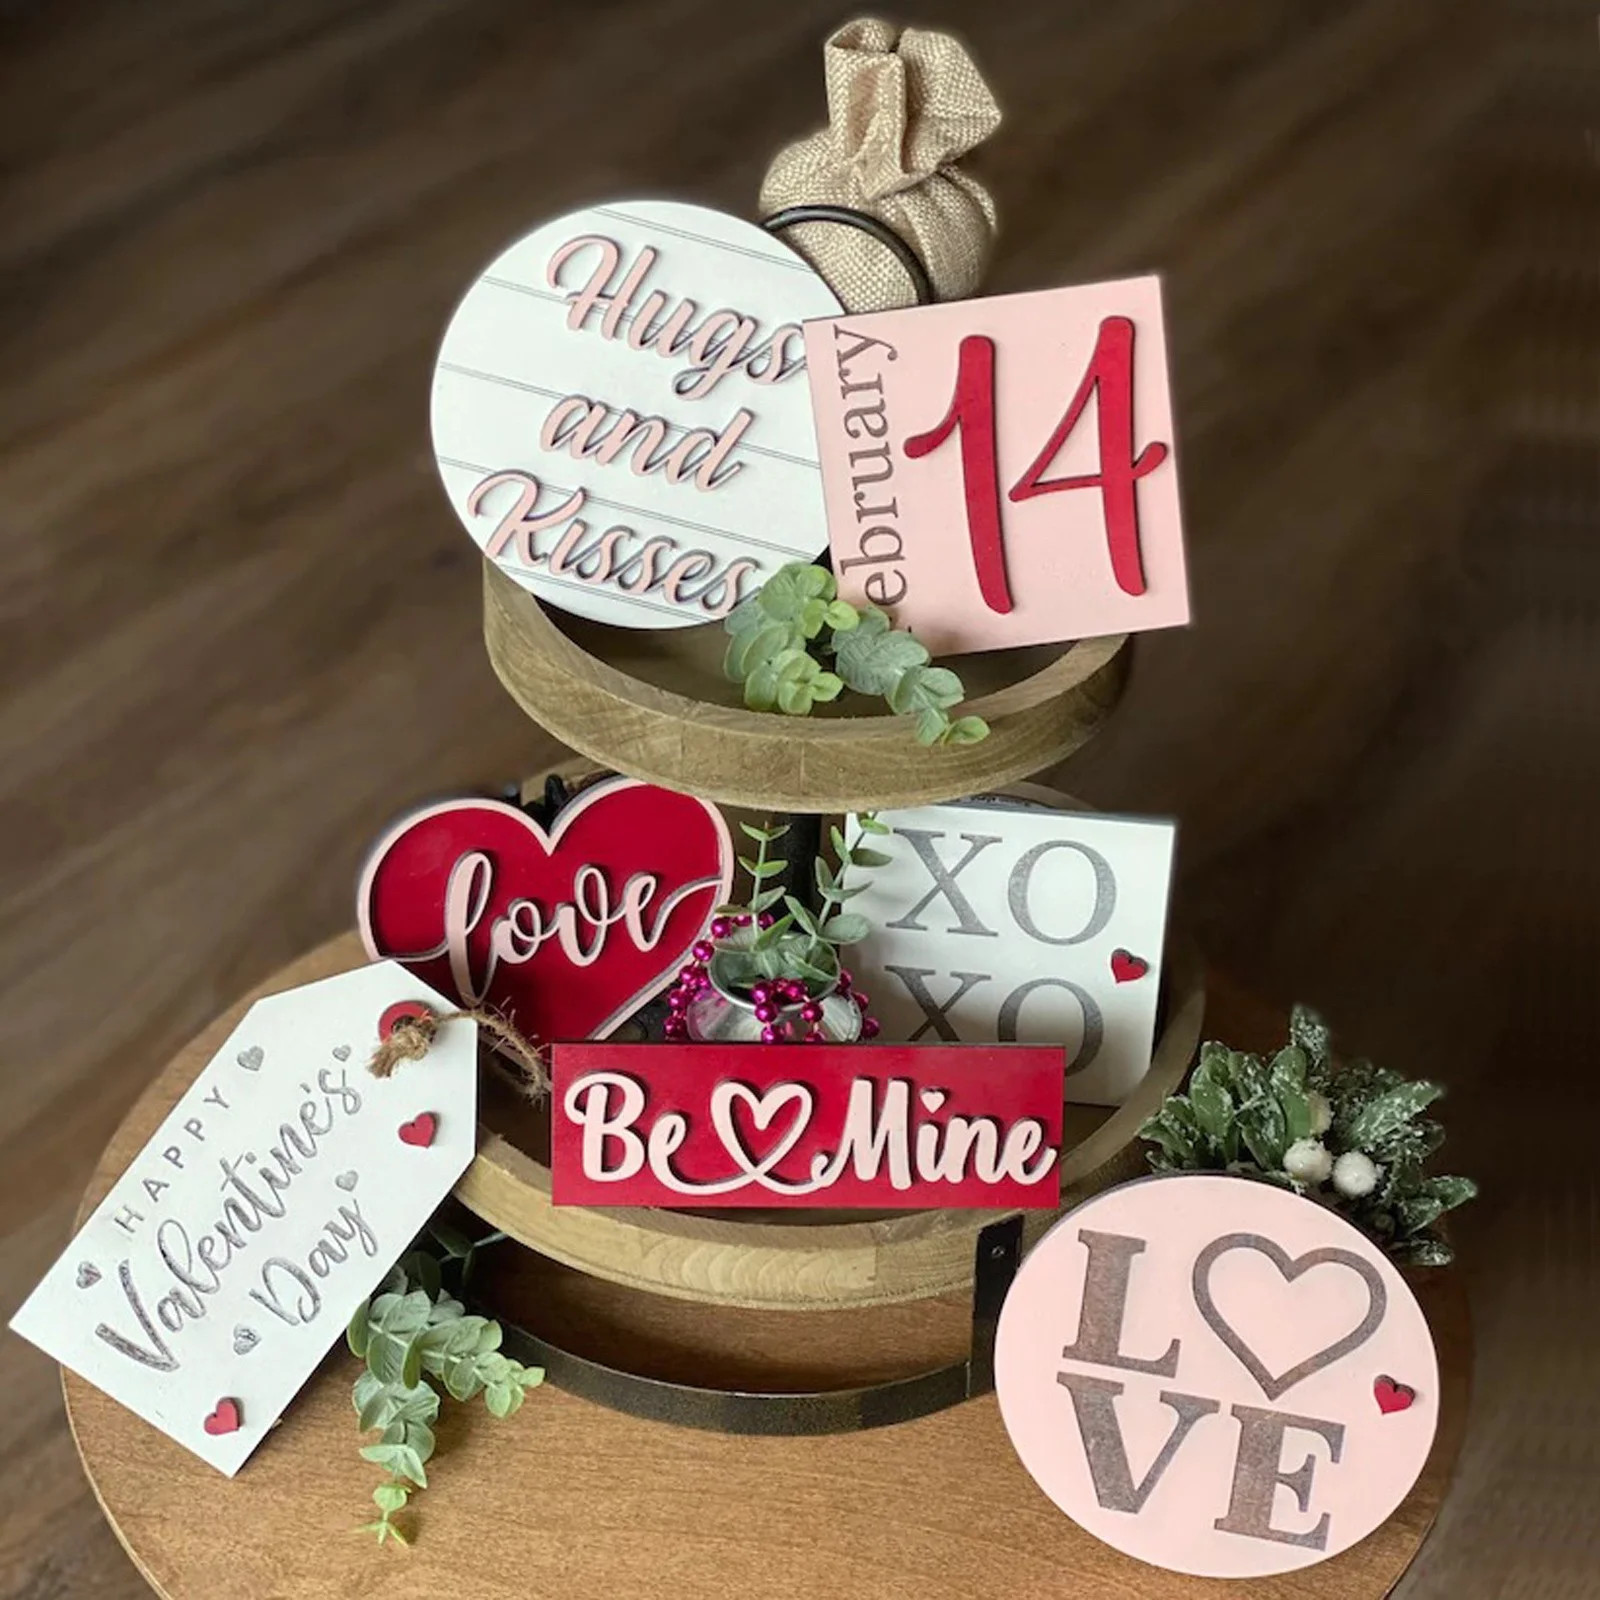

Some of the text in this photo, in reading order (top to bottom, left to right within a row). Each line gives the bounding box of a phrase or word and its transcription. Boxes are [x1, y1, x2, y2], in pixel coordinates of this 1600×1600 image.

[547, 234, 807, 400] Hugs
[540, 394, 755, 492] and
[832, 324, 908, 634] ebruary
[903, 315, 1168, 615] 14
[467, 469, 764, 616] Kisses
[440, 850, 696, 1002] love
[886, 827, 1117, 946] XO
[885, 965, 1104, 1077] XO
[114, 1087, 230, 1233] HAPPY
[564, 1072, 1058, 1190] Be Mine
[95, 1066, 362, 1373] Valentine's
[248, 1198, 378, 1327] Day
